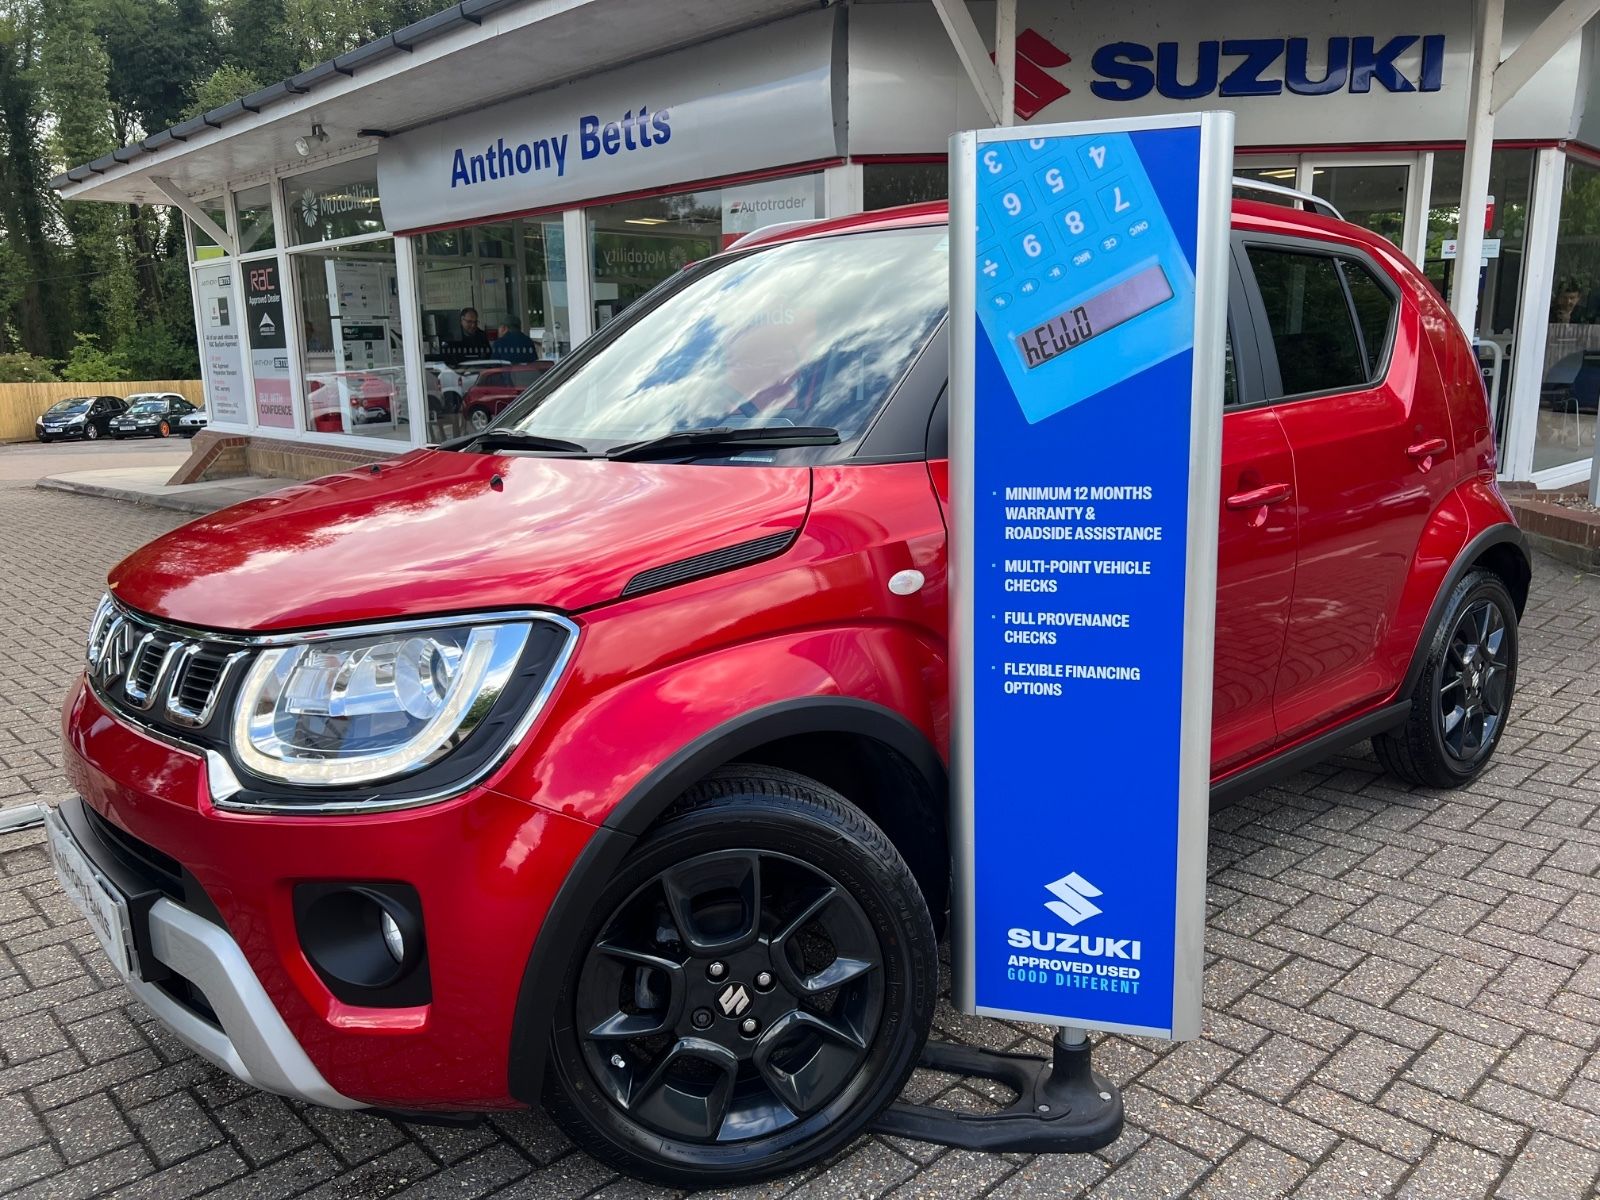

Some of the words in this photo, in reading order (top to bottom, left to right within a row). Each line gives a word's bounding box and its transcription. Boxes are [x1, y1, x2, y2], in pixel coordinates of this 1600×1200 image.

[1090, 35, 1445, 101] SUZUKI
[451, 134, 568, 188] Anthony
[579, 105, 672, 160] Betts
[320, 184, 374, 216] Motability
[740, 197, 806, 213] Autotrader
[1065, 210, 1085, 234] 8
[261, 404, 293, 416] CONFIDENCE
[1005, 487, 1072, 500] MINIMUM
[1073, 487, 1088, 500] 12
[1090, 486, 1153, 500] MONTHS
[1005, 507, 1083, 520] WARRANTY
[1085, 507, 1096, 520] &
[1005, 527, 1073, 540] ROADSIDE
[1074, 527, 1162, 541] ASSISTANCE
[1005, 559, 1092, 574] MULTI-POINT
[1093, 560, 1151, 575] VEHICLE
[1005, 579, 1057, 593] CHECKS
[1004, 611, 1036, 625] FULL
[1037, 612, 1130, 628] PROVENANCE
[1004, 631, 1057, 645] CHECKS
[1004, 662, 1063, 678] FLEXIBLE
[1065, 665, 1141, 681] FINANCING
[1004, 681, 1062, 696] OPTIONS
[1007, 928, 1141, 960] SUZUKI
[1007, 955, 1093, 974] APPROVED
[1096, 965, 1140, 979] USED
[1007, 968, 1048, 984] GOOD
[1055, 974, 1140, 994] DIFFERENT
